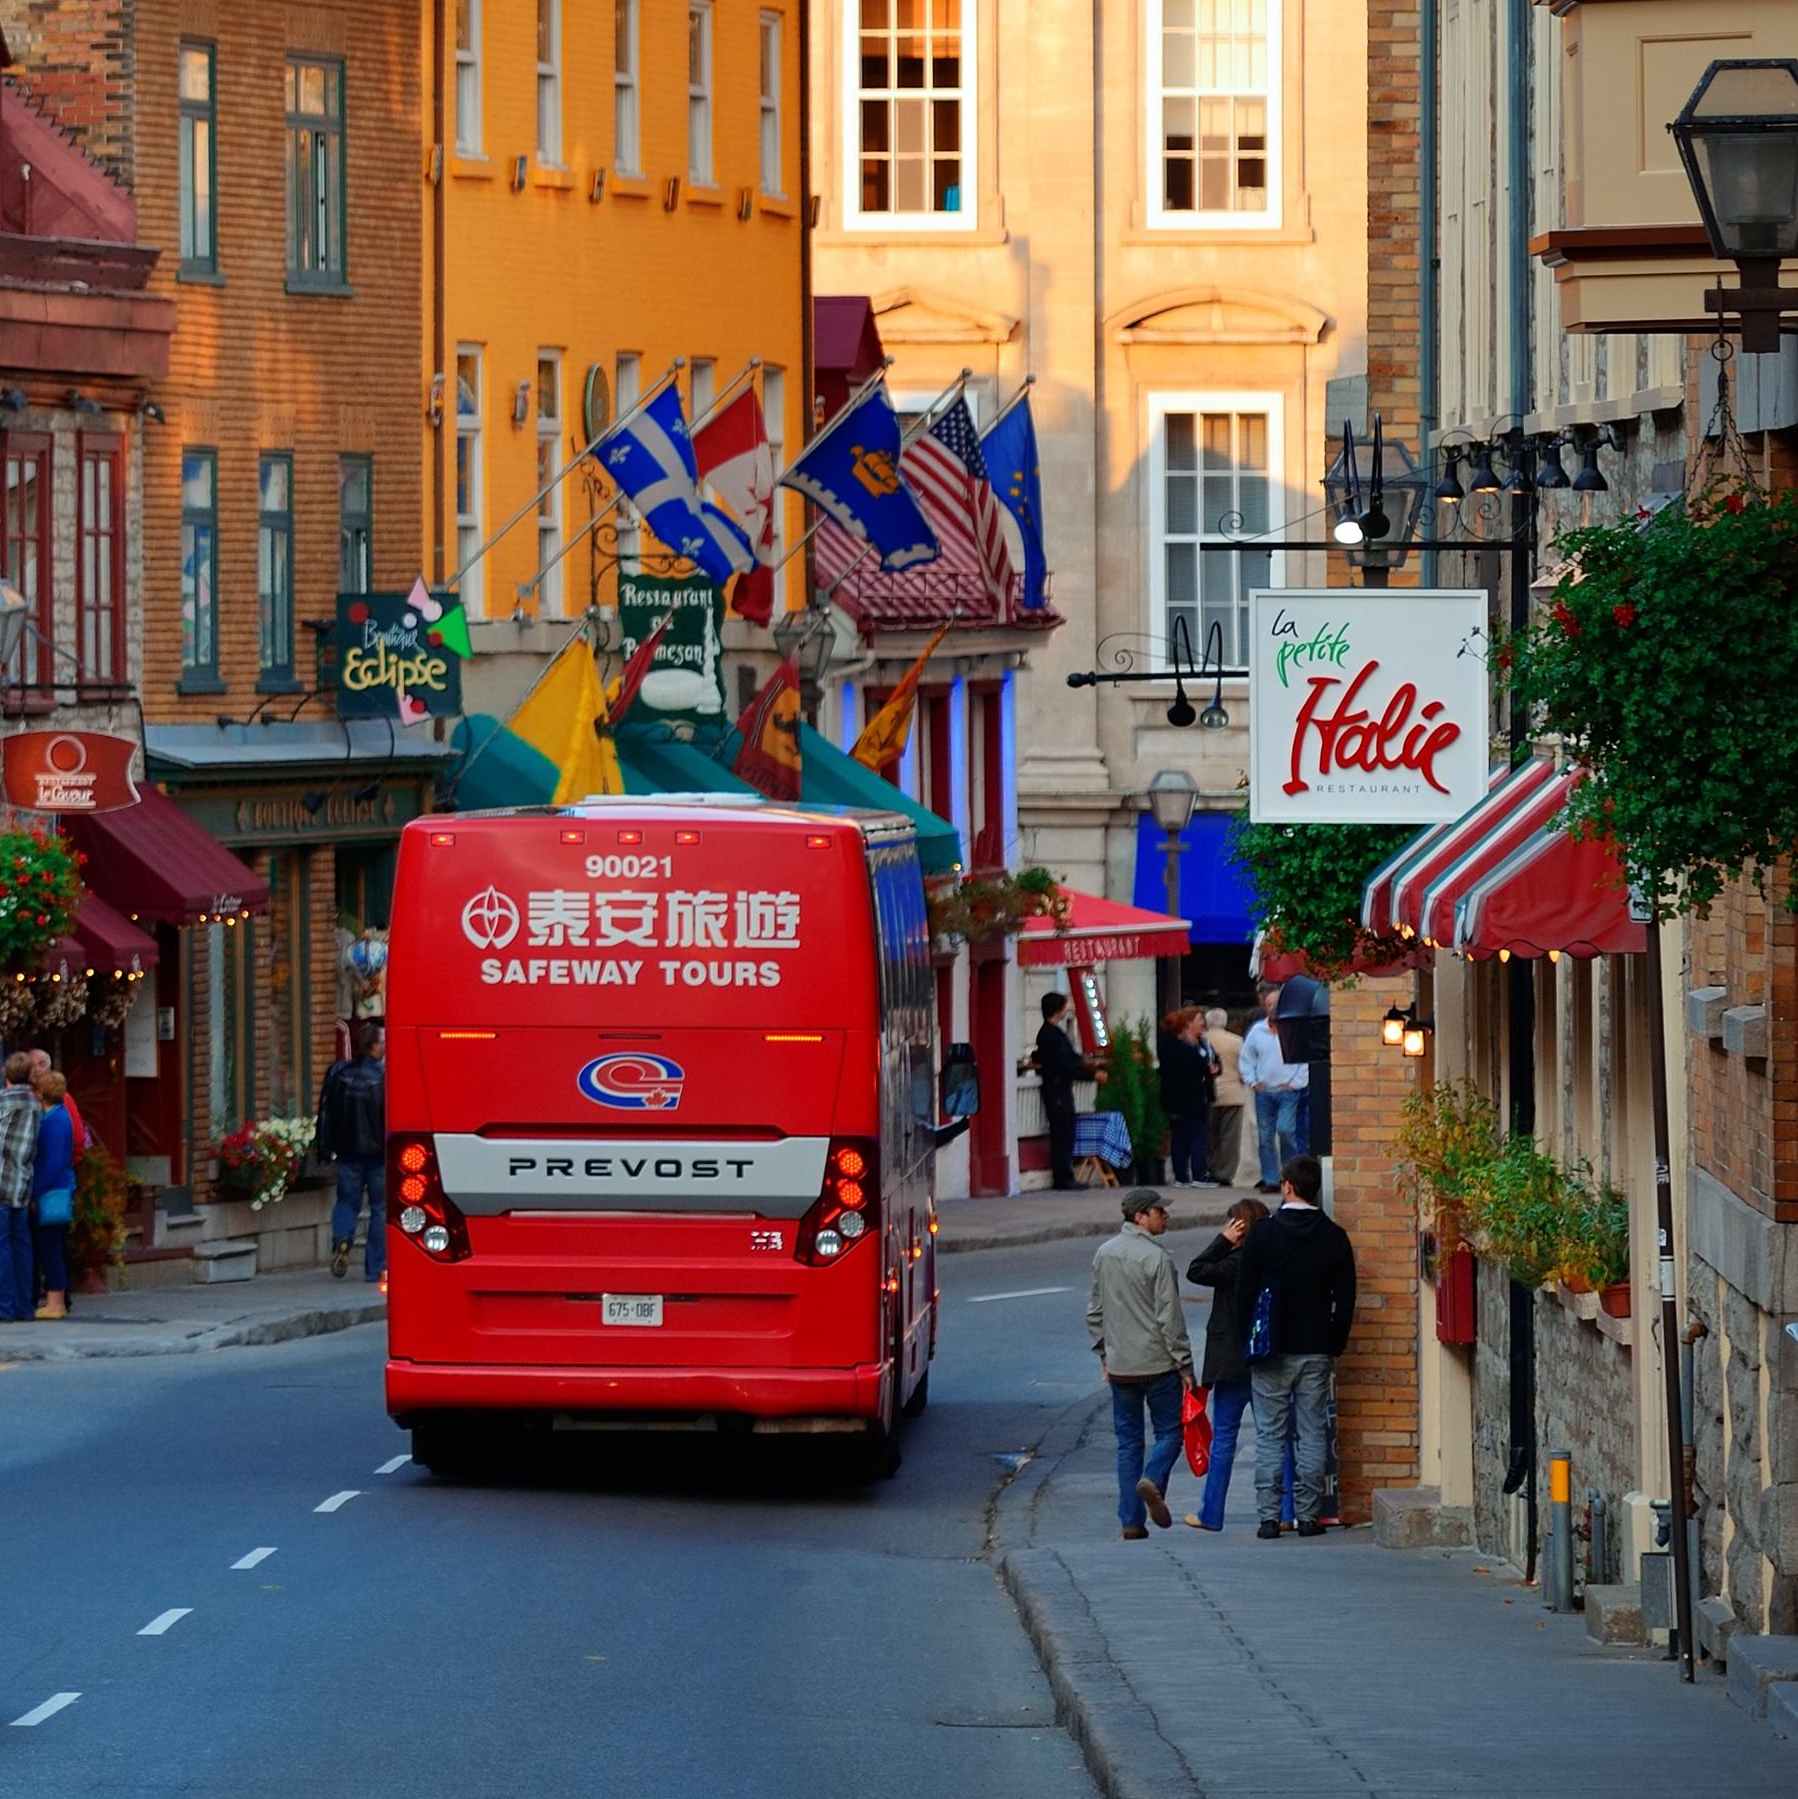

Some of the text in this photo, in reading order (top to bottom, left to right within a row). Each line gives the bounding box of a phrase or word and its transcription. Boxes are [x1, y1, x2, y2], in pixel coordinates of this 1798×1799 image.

[621, 584, 713, 609] Restaurant
[363, 619, 423, 654] Boutique
[342, 638, 447, 697] Eclipse
[1277, 622, 1350, 688] petite
[1282, 660, 1461, 796] Italie
[1316, 785, 1422, 794] RESTAURANT
[585, 855, 673, 878] 90021
[527, 889, 801, 949] 泰安旅遊
[1064, 936, 1140, 960] RESTAURANT
[481, 959, 781, 987] SAFEWAY TOURS
[509, 1158, 754, 1179] PREVOST
